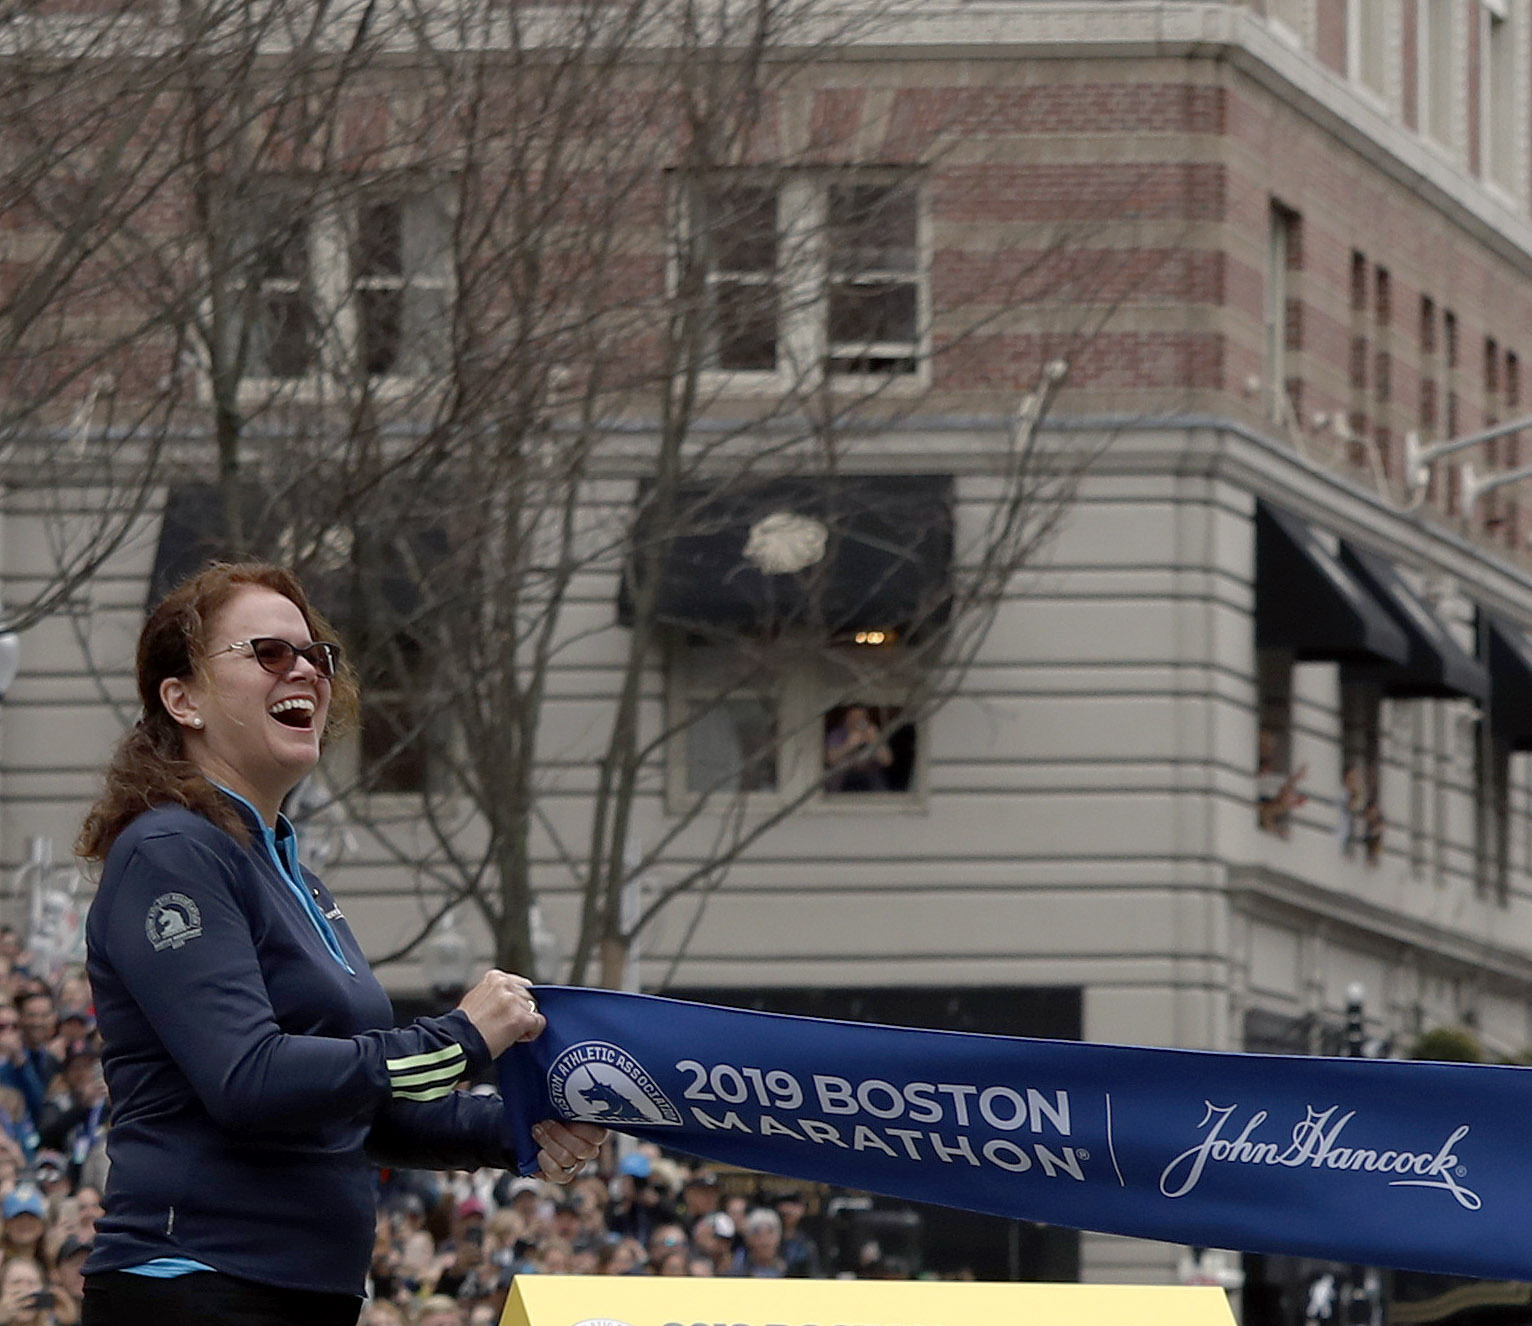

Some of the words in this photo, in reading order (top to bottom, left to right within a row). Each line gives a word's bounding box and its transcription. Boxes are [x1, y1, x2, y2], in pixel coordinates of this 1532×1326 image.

[557, 1047, 616, 1076] ATHLETIC
[675, 1060, 804, 1109] 2019
[813, 1074, 1071, 1136] BOSTON
[691, 1107, 1086, 1181] MARATHON
